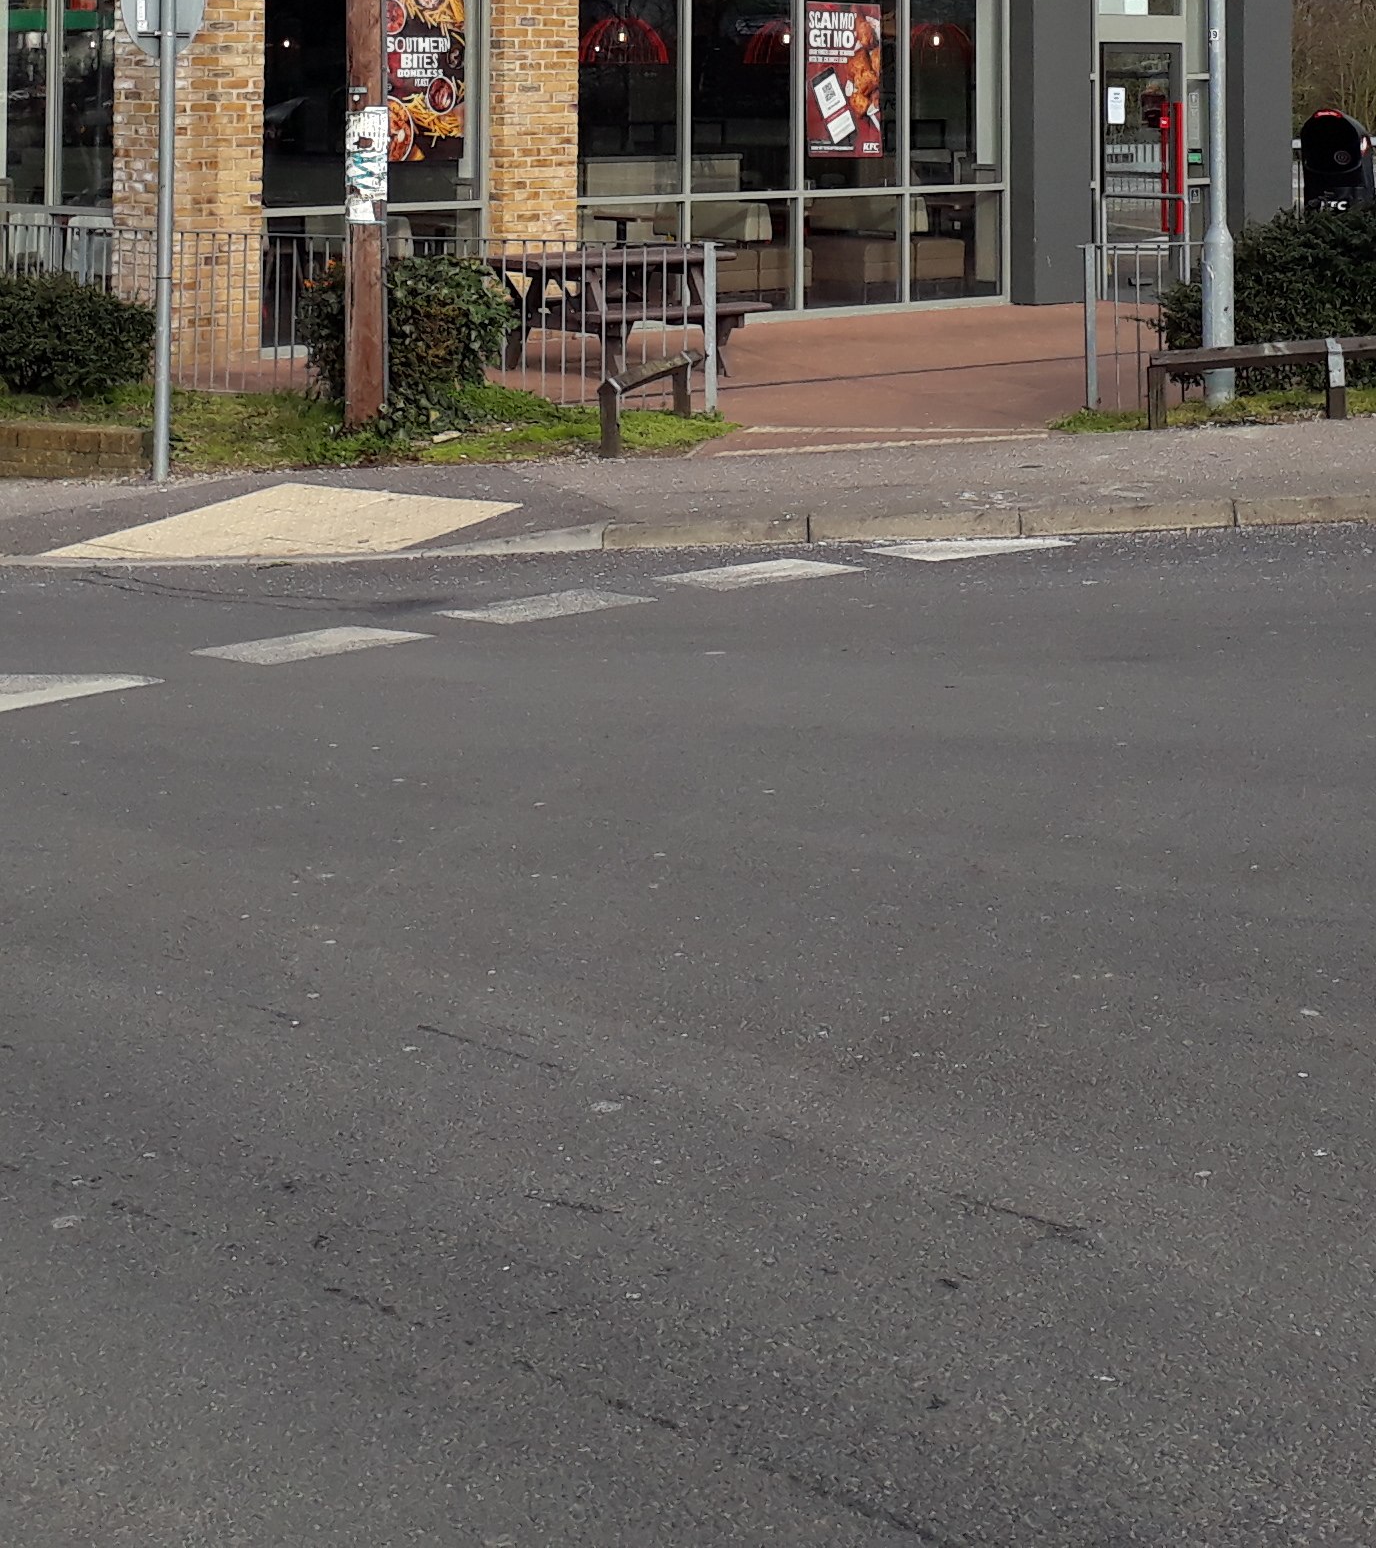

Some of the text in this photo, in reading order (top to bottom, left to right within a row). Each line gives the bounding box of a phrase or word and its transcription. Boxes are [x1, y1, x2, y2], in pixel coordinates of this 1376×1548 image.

[808, 10, 838, 30] SCAN
[386, 36, 450, 53] SOUTHERN
[808, 29, 831, 48] GET
[401, 53, 439, 69] BITES
[863, 142, 880, 152] KFC
